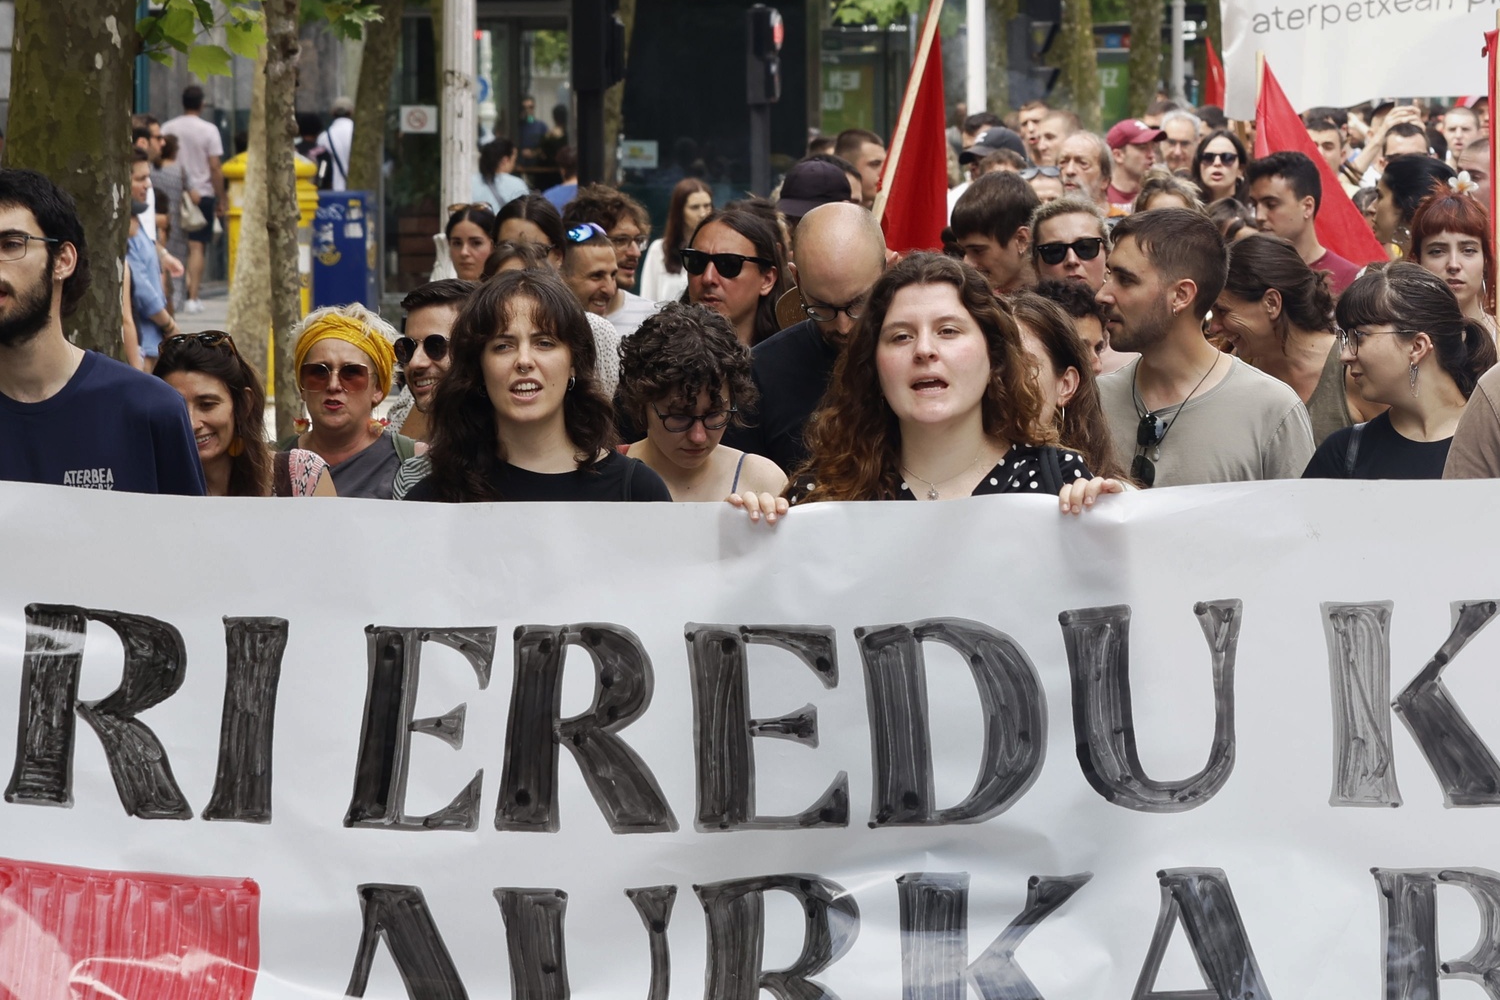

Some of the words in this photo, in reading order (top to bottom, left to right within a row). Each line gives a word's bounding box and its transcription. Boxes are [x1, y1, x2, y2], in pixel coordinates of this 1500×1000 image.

[63, 467, 115, 485] ATERBEA
[3, 602, 290, 825] RI
[343, 598, 1243, 833] EREDU
